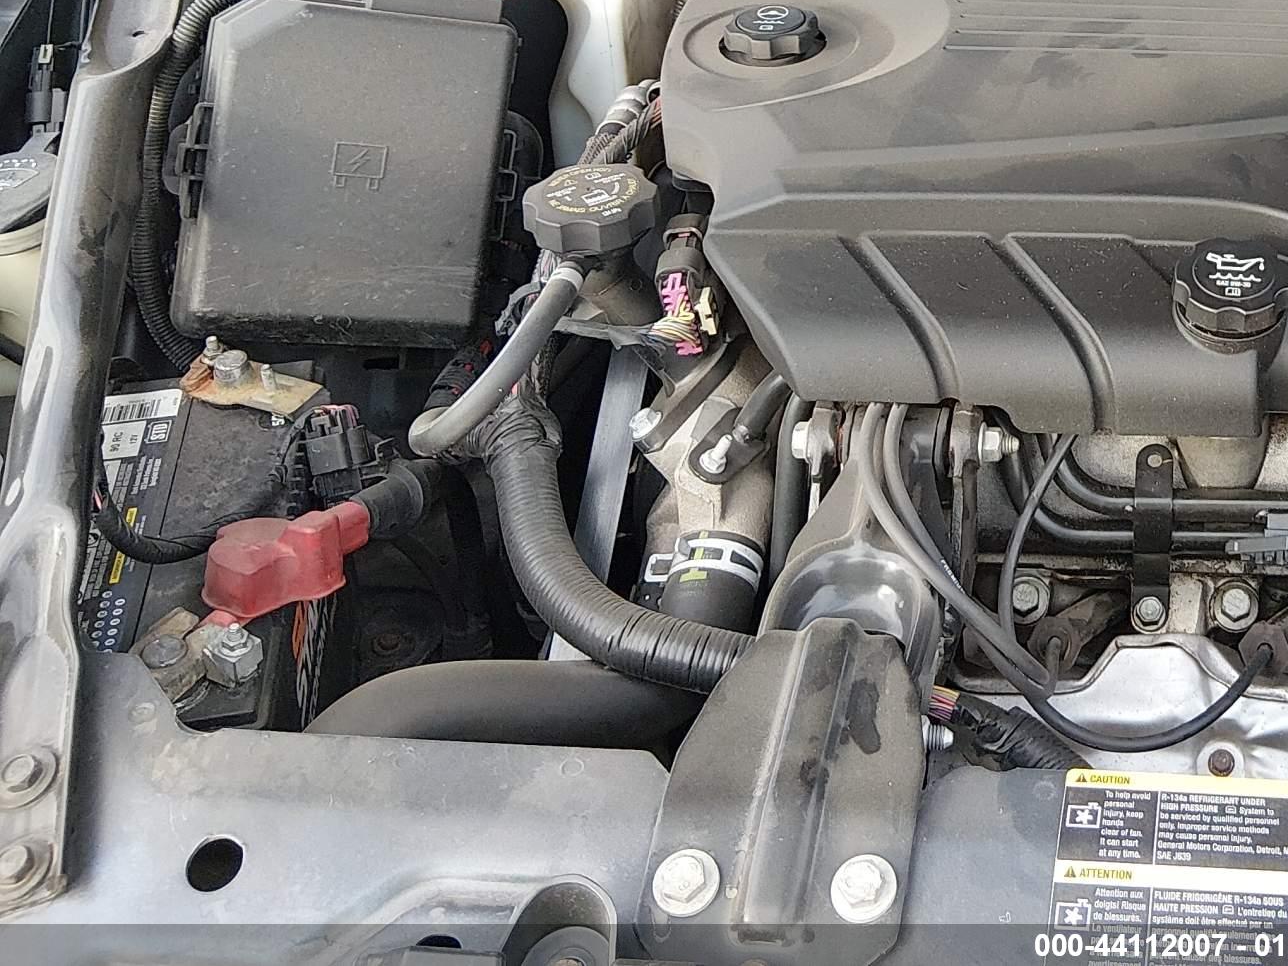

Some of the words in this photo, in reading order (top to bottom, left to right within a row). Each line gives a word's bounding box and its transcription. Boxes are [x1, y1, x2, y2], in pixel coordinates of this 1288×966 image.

[150, 423, 168, 441] STD
[1090, 775, 1130, 784] CAUTION
[1132, 792, 1151, 800] avoid
[1161, 793, 1188, 802] R-134a
[1189, 795, 1239, 805] REFRIGERANT
[1240, 797, 1266, 806] UNDER
[1161, 802, 1178, 811] HIGH
[1180, 804, 1218, 813] PRESSURE
[1239, 807, 1265, 816] System
[1126, 811, 1144, 819] keep
[1171, 812, 1200, 821] serviced
[1202, 814, 1210, 823] by
[1213, 814, 1243, 825] qualified
[1244, 816, 1279, 826] personnel
[1102, 818, 1124, 826] hands
[1211, 824, 1236, 832] service
[1238, 826, 1269, 834] methods
[1158, 832, 1174, 840] may
[1198, 834, 1229, 843] personal
[1122, 839, 1139, 847] start
[1158, 841, 1184, 849] General
[1186, 842, 1210, 851] Motors
[1212, 843, 1255, 854] Corporation,
[1108, 849, 1120, 858] any
[1157, 851, 1171, 860] SAE
[1173, 852, 1191, 861] J639
[1080, 868, 1132, 880] ATTENTION
[1095, 888, 1128, 898] Attention
[1154, 891, 1181, 900] FLUIDE
[1234, 895, 1261, 904] R-134a
[1262, 896, 1284, 906] SOUS
[1121, 901, 1146, 911] Risque
[1153, 902, 1179, 912] HAUTE
[1180, 904, 1218, 914] PRESSION
[1278, 909, 1287, 918] du
[1093, 912, 1102, 920] de
[1185, 916, 1199, 925] doit
[1249, 921, 1262, 929] par
